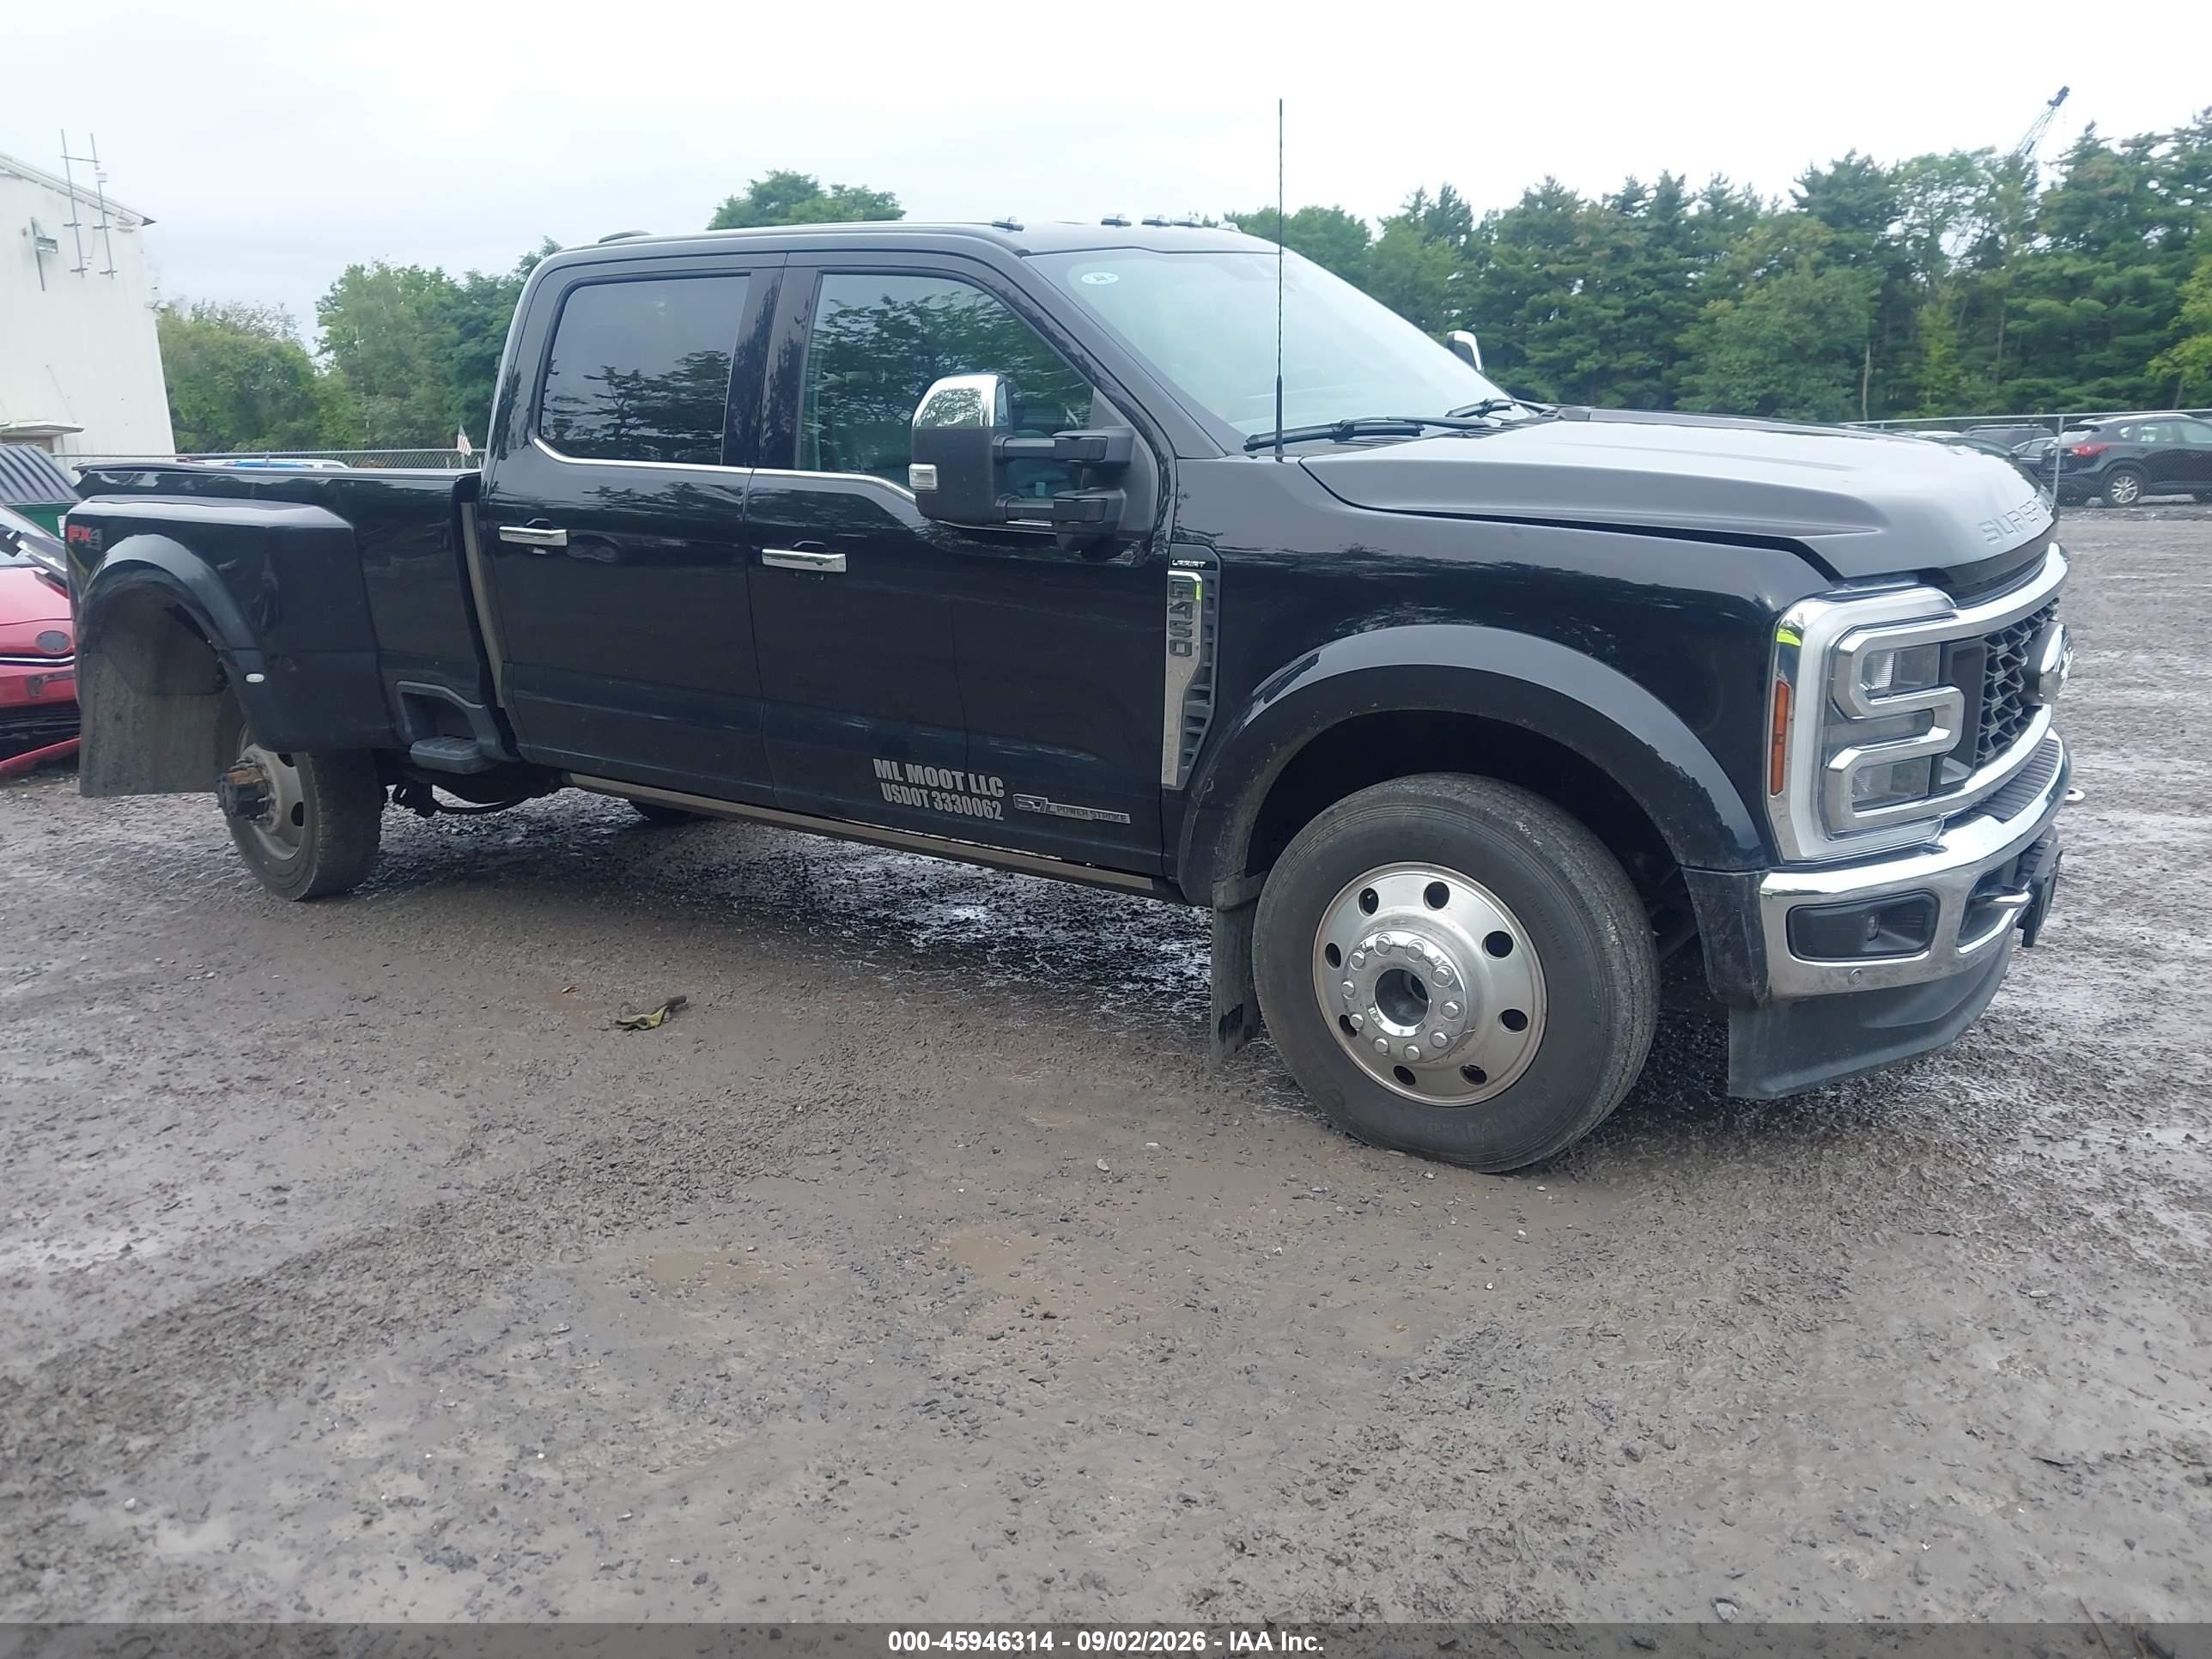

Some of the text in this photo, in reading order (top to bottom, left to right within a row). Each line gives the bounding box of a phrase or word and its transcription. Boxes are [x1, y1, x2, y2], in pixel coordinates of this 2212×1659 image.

[68, 525, 102, 550] FX4
[872, 758, 1005, 799] ML MOOT LLC
[880, 781, 1005, 821] USDOT 3330062
[1056, 805, 1089, 818] POWER
[1090, 810, 1129, 823] STROKE
